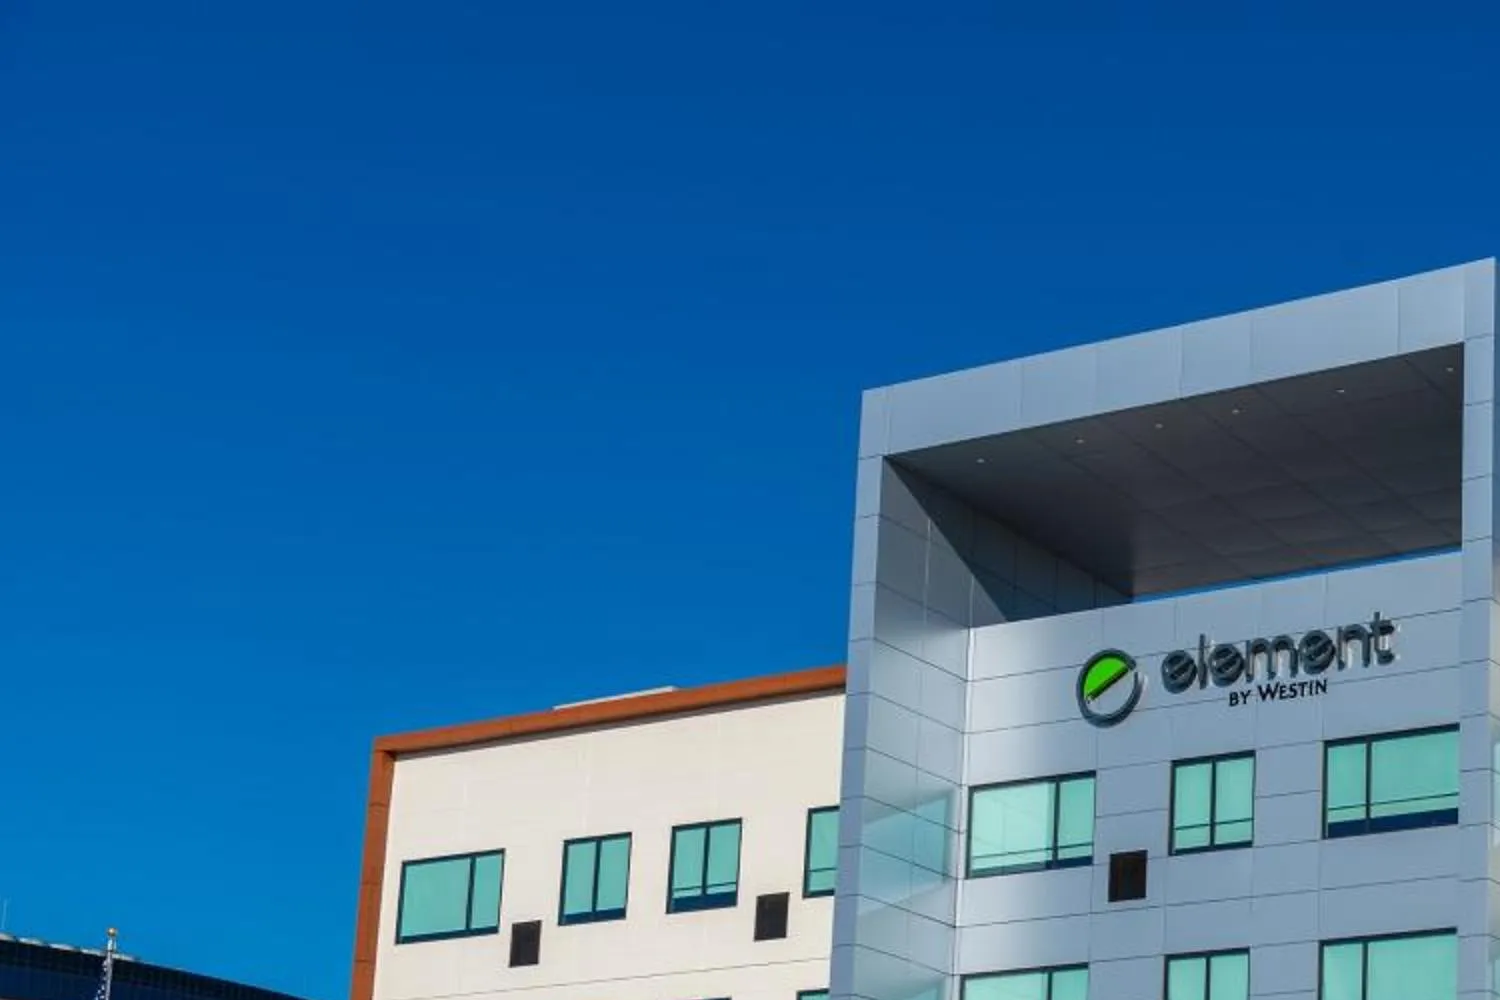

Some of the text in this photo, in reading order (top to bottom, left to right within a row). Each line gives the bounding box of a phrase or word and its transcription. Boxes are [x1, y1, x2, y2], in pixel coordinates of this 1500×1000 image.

[1161, 611, 1396, 693] element
[1229, 679, 1328, 707] BY WESTIN
